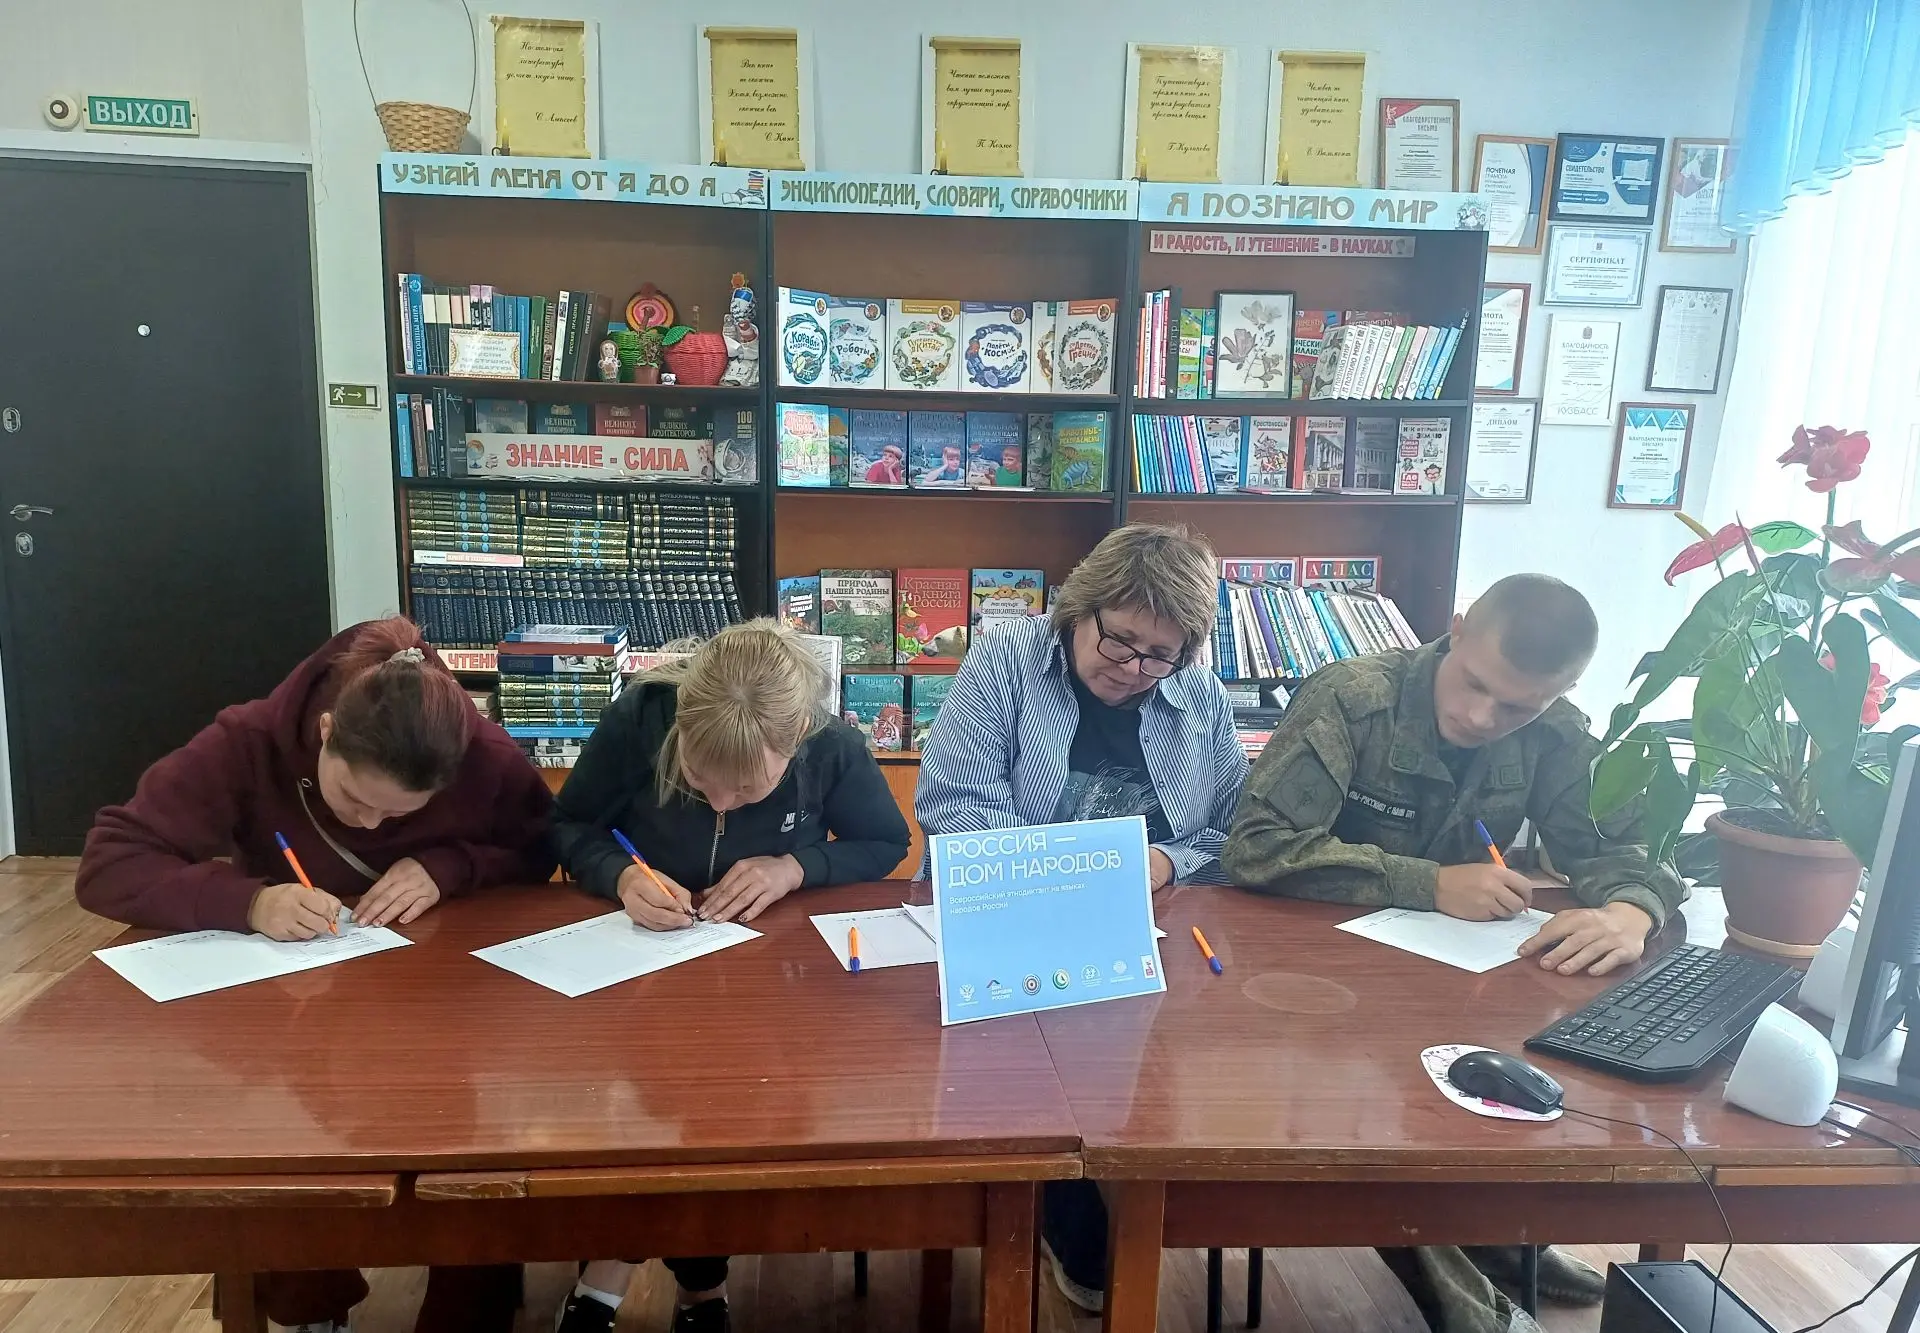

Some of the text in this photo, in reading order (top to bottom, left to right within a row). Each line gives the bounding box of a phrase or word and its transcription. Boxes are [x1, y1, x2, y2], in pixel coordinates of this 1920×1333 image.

[94, 100, 188, 128] ВЫХОД
[1566, 164, 1605, 174] СВИДЕТЕЛЬСТВО
[392, 162, 716, 197] УЗНАЙ МЕНЯ ОТ А ДО Я
[780, 179, 1128, 213] ЭНЦИКЛОПЕДИИ, СЛОВАРИ, СПРАВОЧНИКИ
[1166, 192, 1438, 224] Я ПОЗНАЮ МИР
[1154, 234, 1164, 250] И
[1167, 235, 1232, 254] РАДОСТЬ,
[1234, 236, 1246, 252] И
[1248, 237, 1319, 253] УТЕШЕНИЕ
[1330, 239, 1339, 254] В
[1342, 240, 1394, 255] НАУКАХ
[1570, 256, 1625, 264] СЕРТИФИКАТ
[836, 344, 870, 355] Роботы
[604, 420, 636, 428] ВЕЛИКИХ
[736, 411, 752, 424] 100
[652, 430, 696, 438] АРХИТЕКТОРОВ
[506, 443, 603, 468] ЗНАНИЕ
[624, 446, 689, 471] СИЛА
[1227, 564, 1292, 579] АТЛАС
[1308, 561, 1374, 576] АТЛАС
[826, 587, 890, 596] НАШЕЙ РОДИНЫ
[838, 580, 878, 588] ПРИРОДА
[902, 576, 960, 592] Красная
[913, 595, 961, 608] России
[922, 590, 961, 600] книга
[448, 653, 498, 669] ЧТЕНИ
[785, 812, 796, 825] NI
[946, 831, 1048, 861] РОССИЯ
[948, 849, 1122, 888] ДОМ НАРОДОВ
[949, 890, 1006, 905] Всероссийский
[1006, 886, 1050, 898] этнодиктант
[1061, 882, 1086, 892] языках
[950, 902, 1008, 915] народов России
